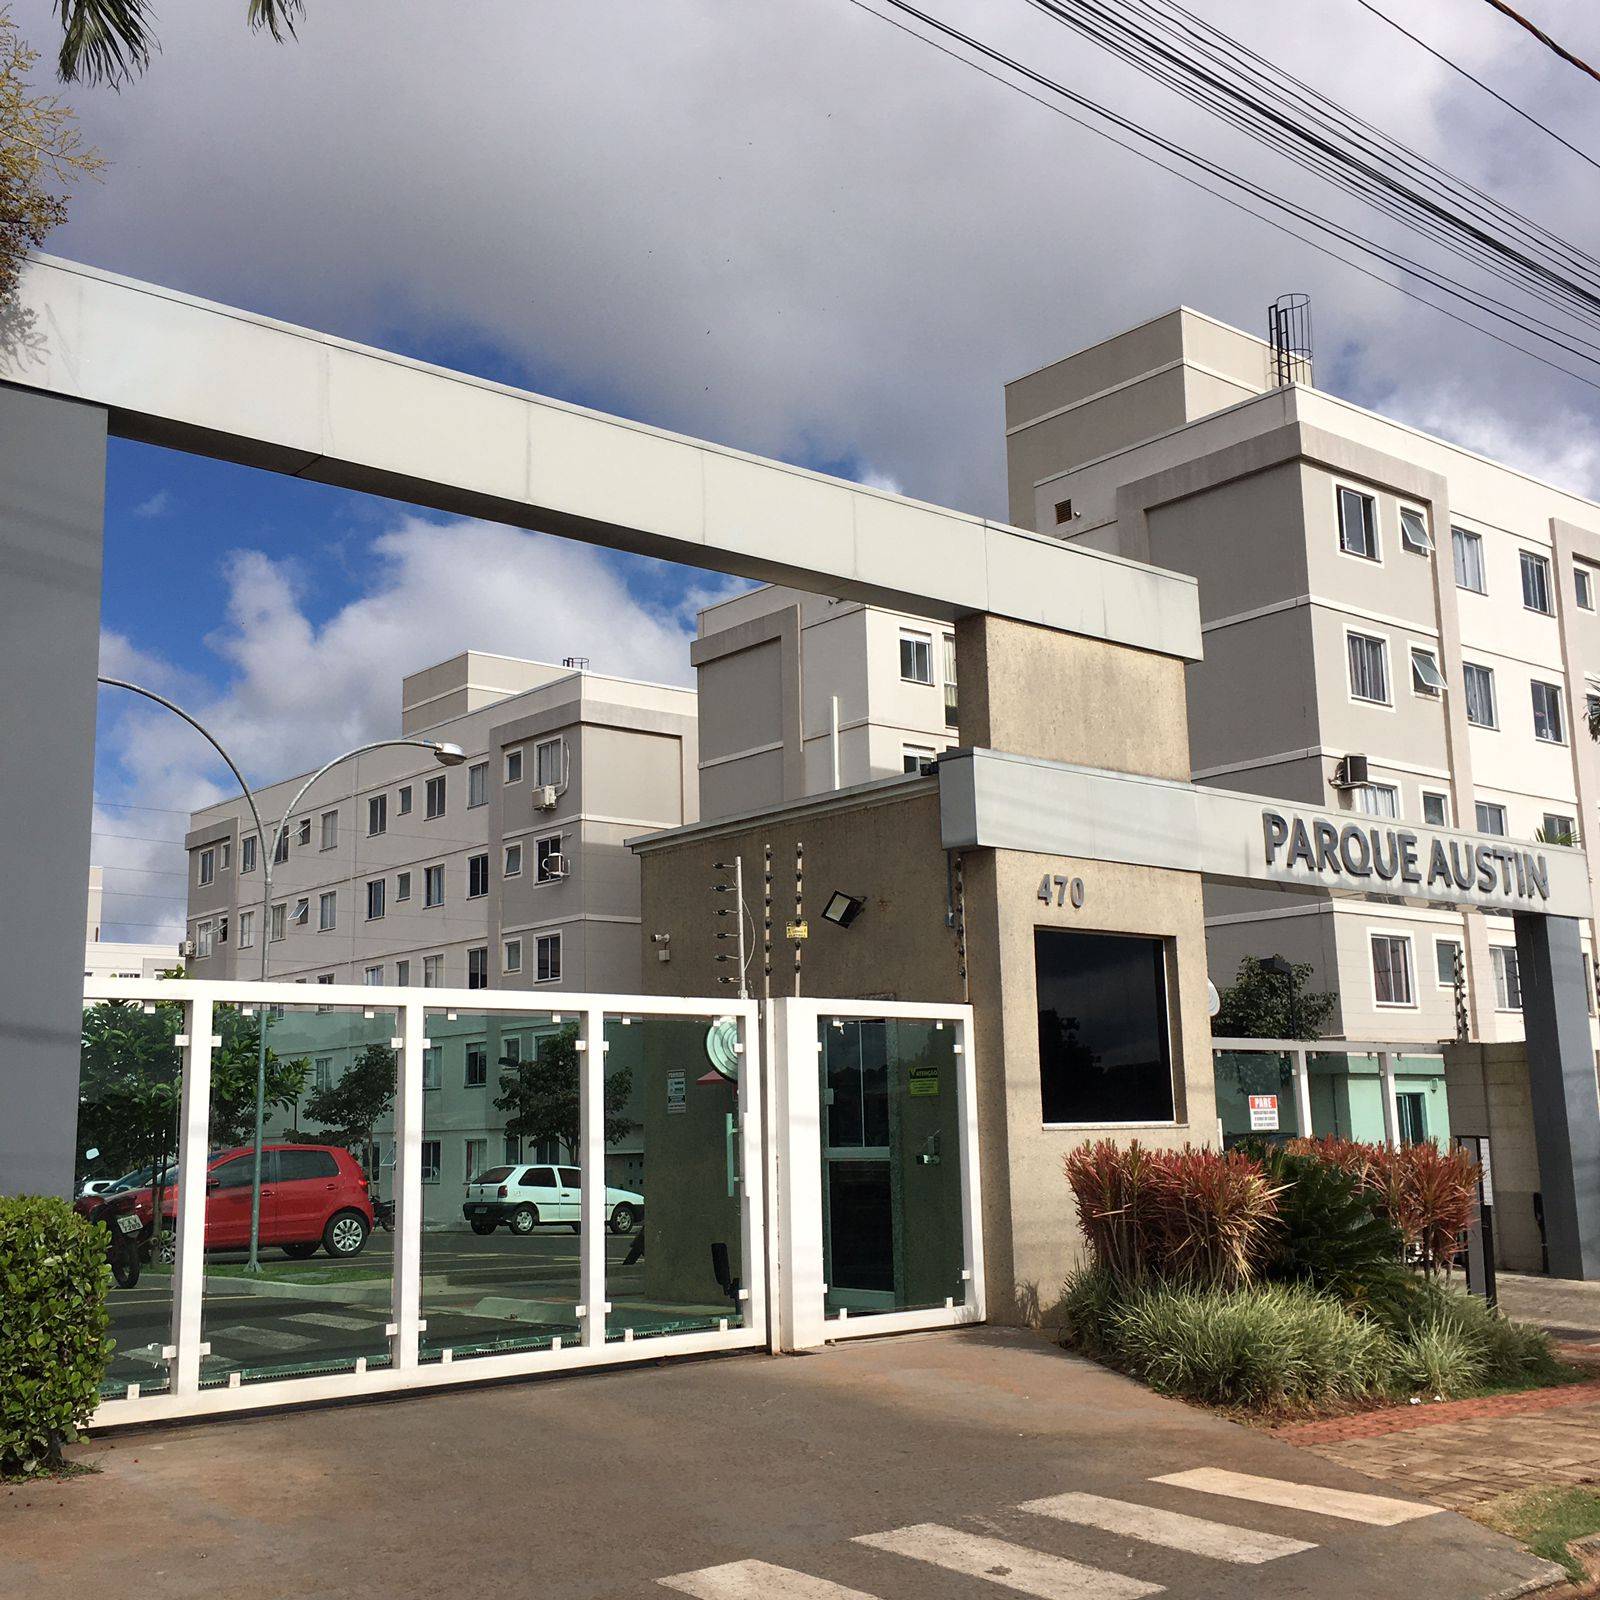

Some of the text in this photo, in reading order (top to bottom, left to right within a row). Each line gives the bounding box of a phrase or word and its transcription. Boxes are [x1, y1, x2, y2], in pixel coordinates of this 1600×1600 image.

[1262, 810, 1551, 900] PARQUE AUSTIN
[1037, 874, 1085, 909] 470
[1254, 1097, 1272, 1108] PARE
